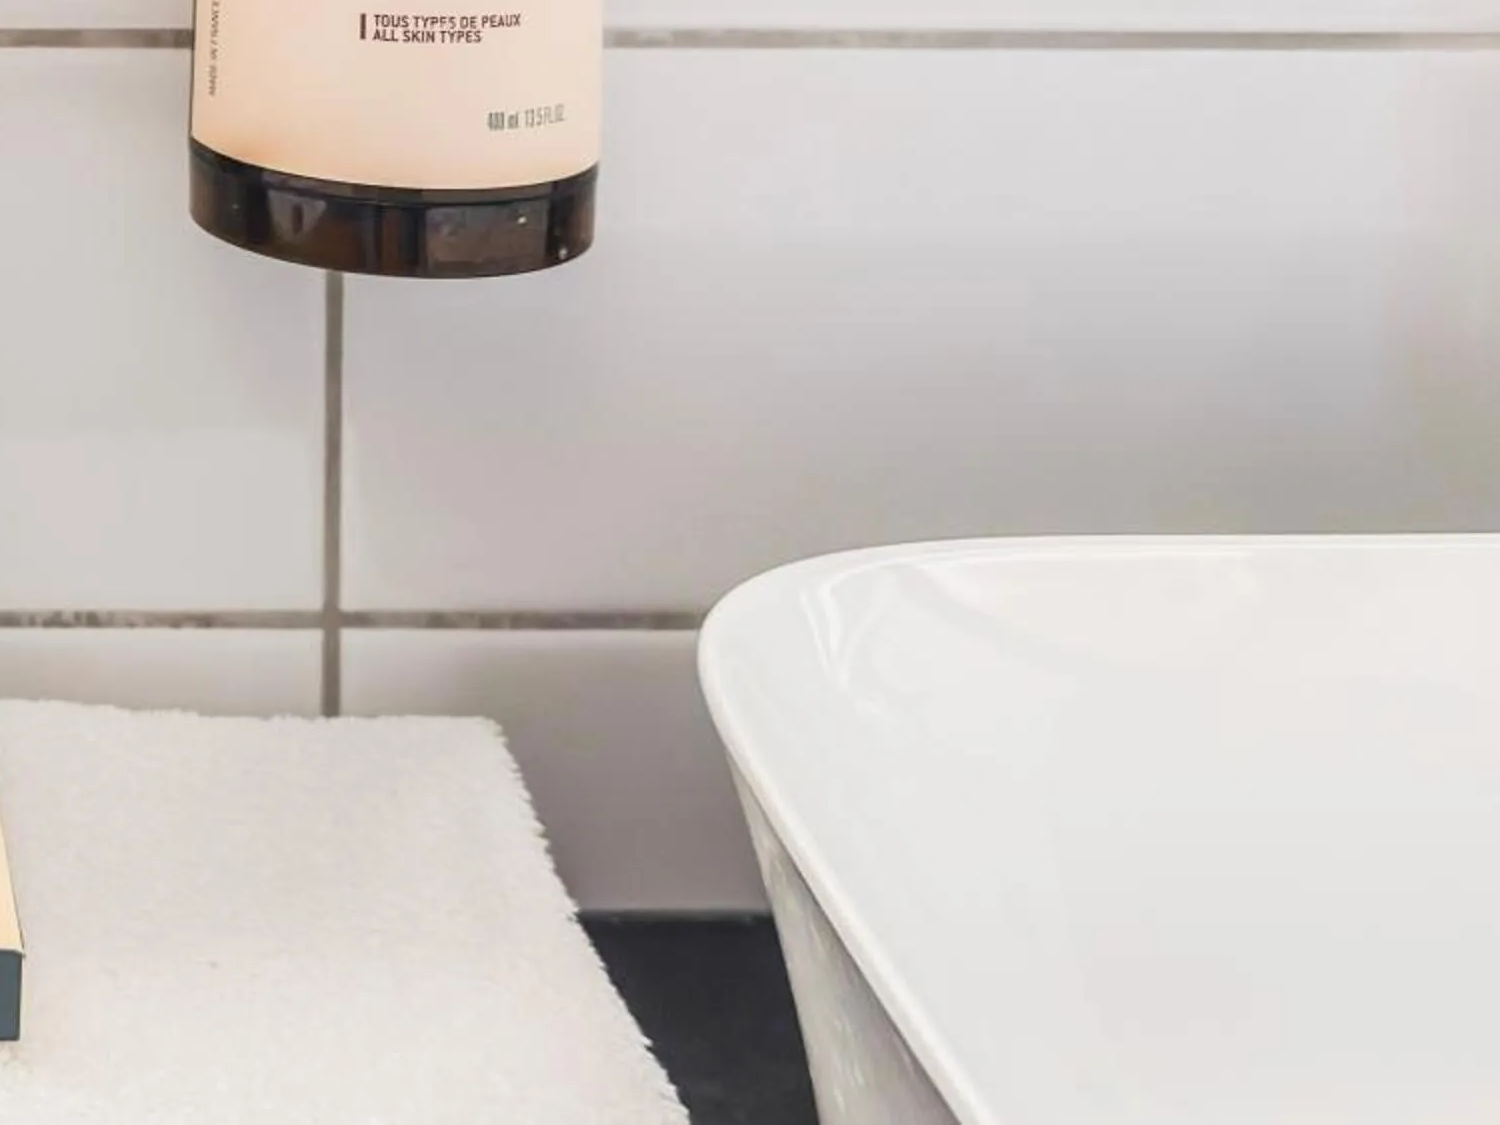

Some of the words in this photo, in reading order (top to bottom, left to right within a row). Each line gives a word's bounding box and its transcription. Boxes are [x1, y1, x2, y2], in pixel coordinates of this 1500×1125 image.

[374, 14, 409, 28] TOUS
[413, 16, 456, 29] TYPES
[460, 16, 477, 29] DE
[481, 13, 521, 28] PEAUX
[372, 29, 399, 42] ALL
[403, 30, 435, 43] SKIN
[439, 30, 482, 44] TYPES
